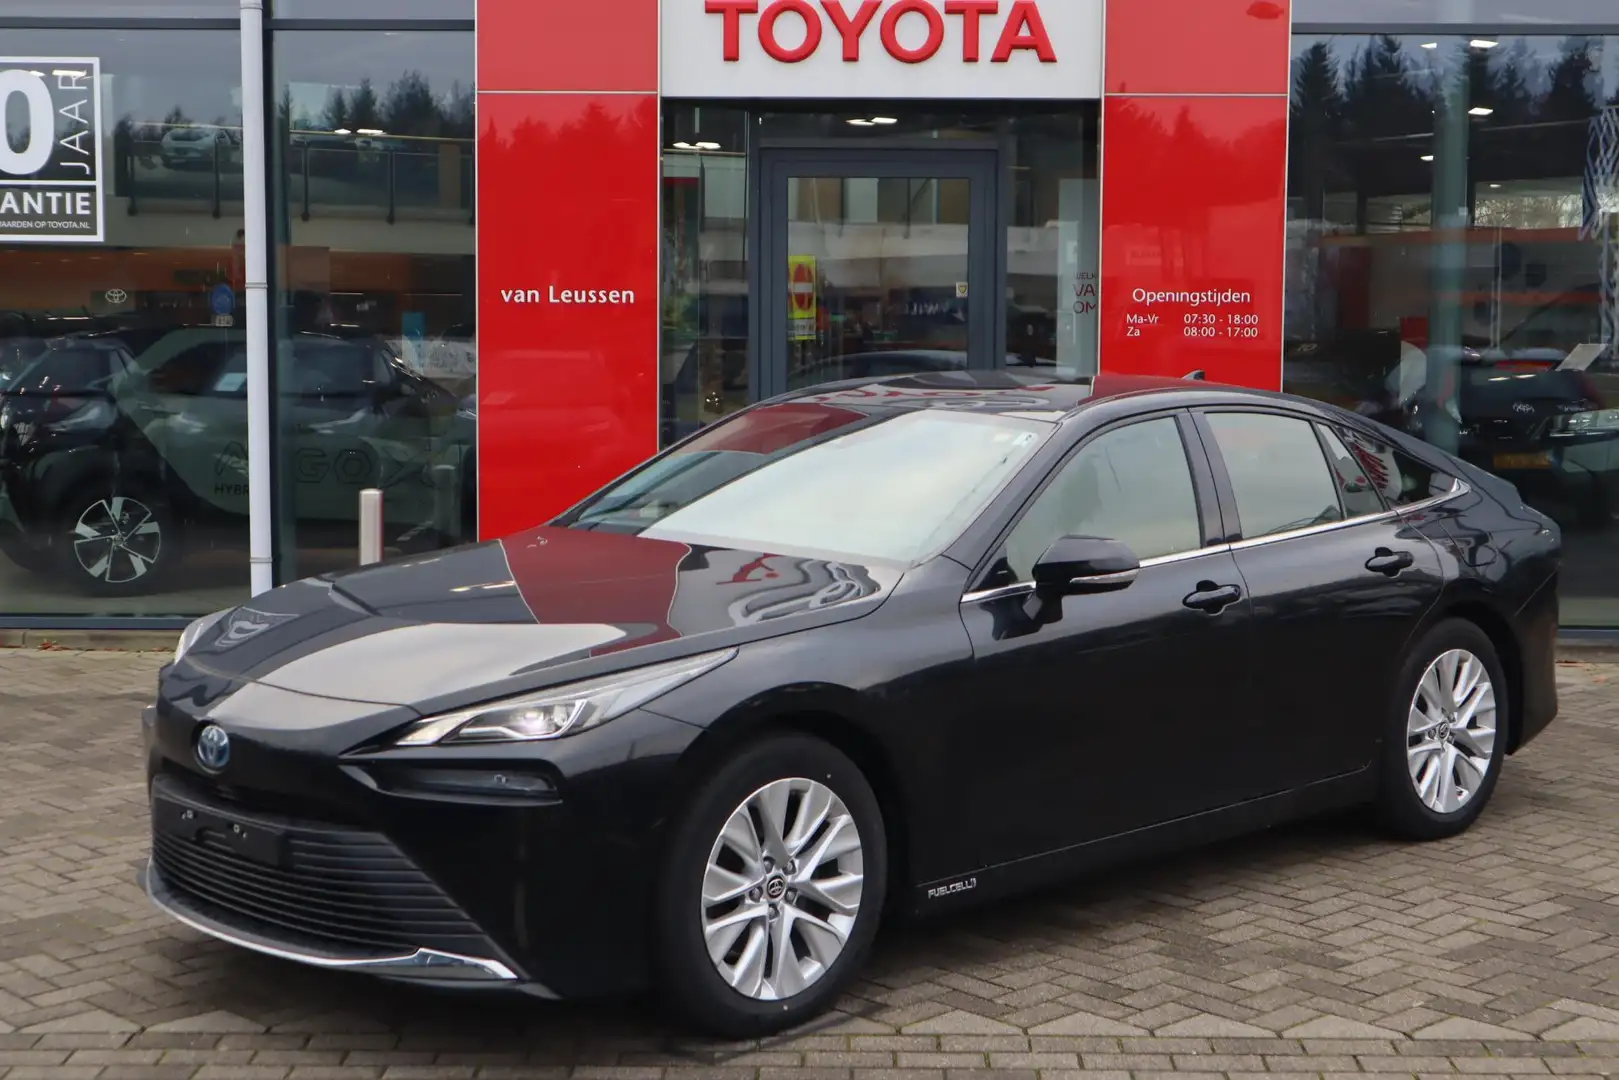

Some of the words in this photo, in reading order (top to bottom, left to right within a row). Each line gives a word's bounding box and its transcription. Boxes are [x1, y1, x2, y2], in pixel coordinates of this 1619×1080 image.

[705, 0, 1058, 63] TOYOTA
[57, 69, 91, 175] JAAR
[0, 191, 91, 215] ANTIE
[34, 220, 46, 229] OP
[48, 220, 91, 229] TOYOTA.NL
[500, 289, 540, 303] van
[548, 285, 635, 304] Leussen
[1132, 288, 1251, 306] Openingstijden
[1126, 313, 1159, 324] Ma-Vr
[1183, 313, 1216, 324] 07:30
[1227, 314, 1259, 325] 18:00
[1126, 326, 1141, 337] Za
[1183, 326, 1216, 337] 08:00
[1226, 327, 1259, 338] 17:00
